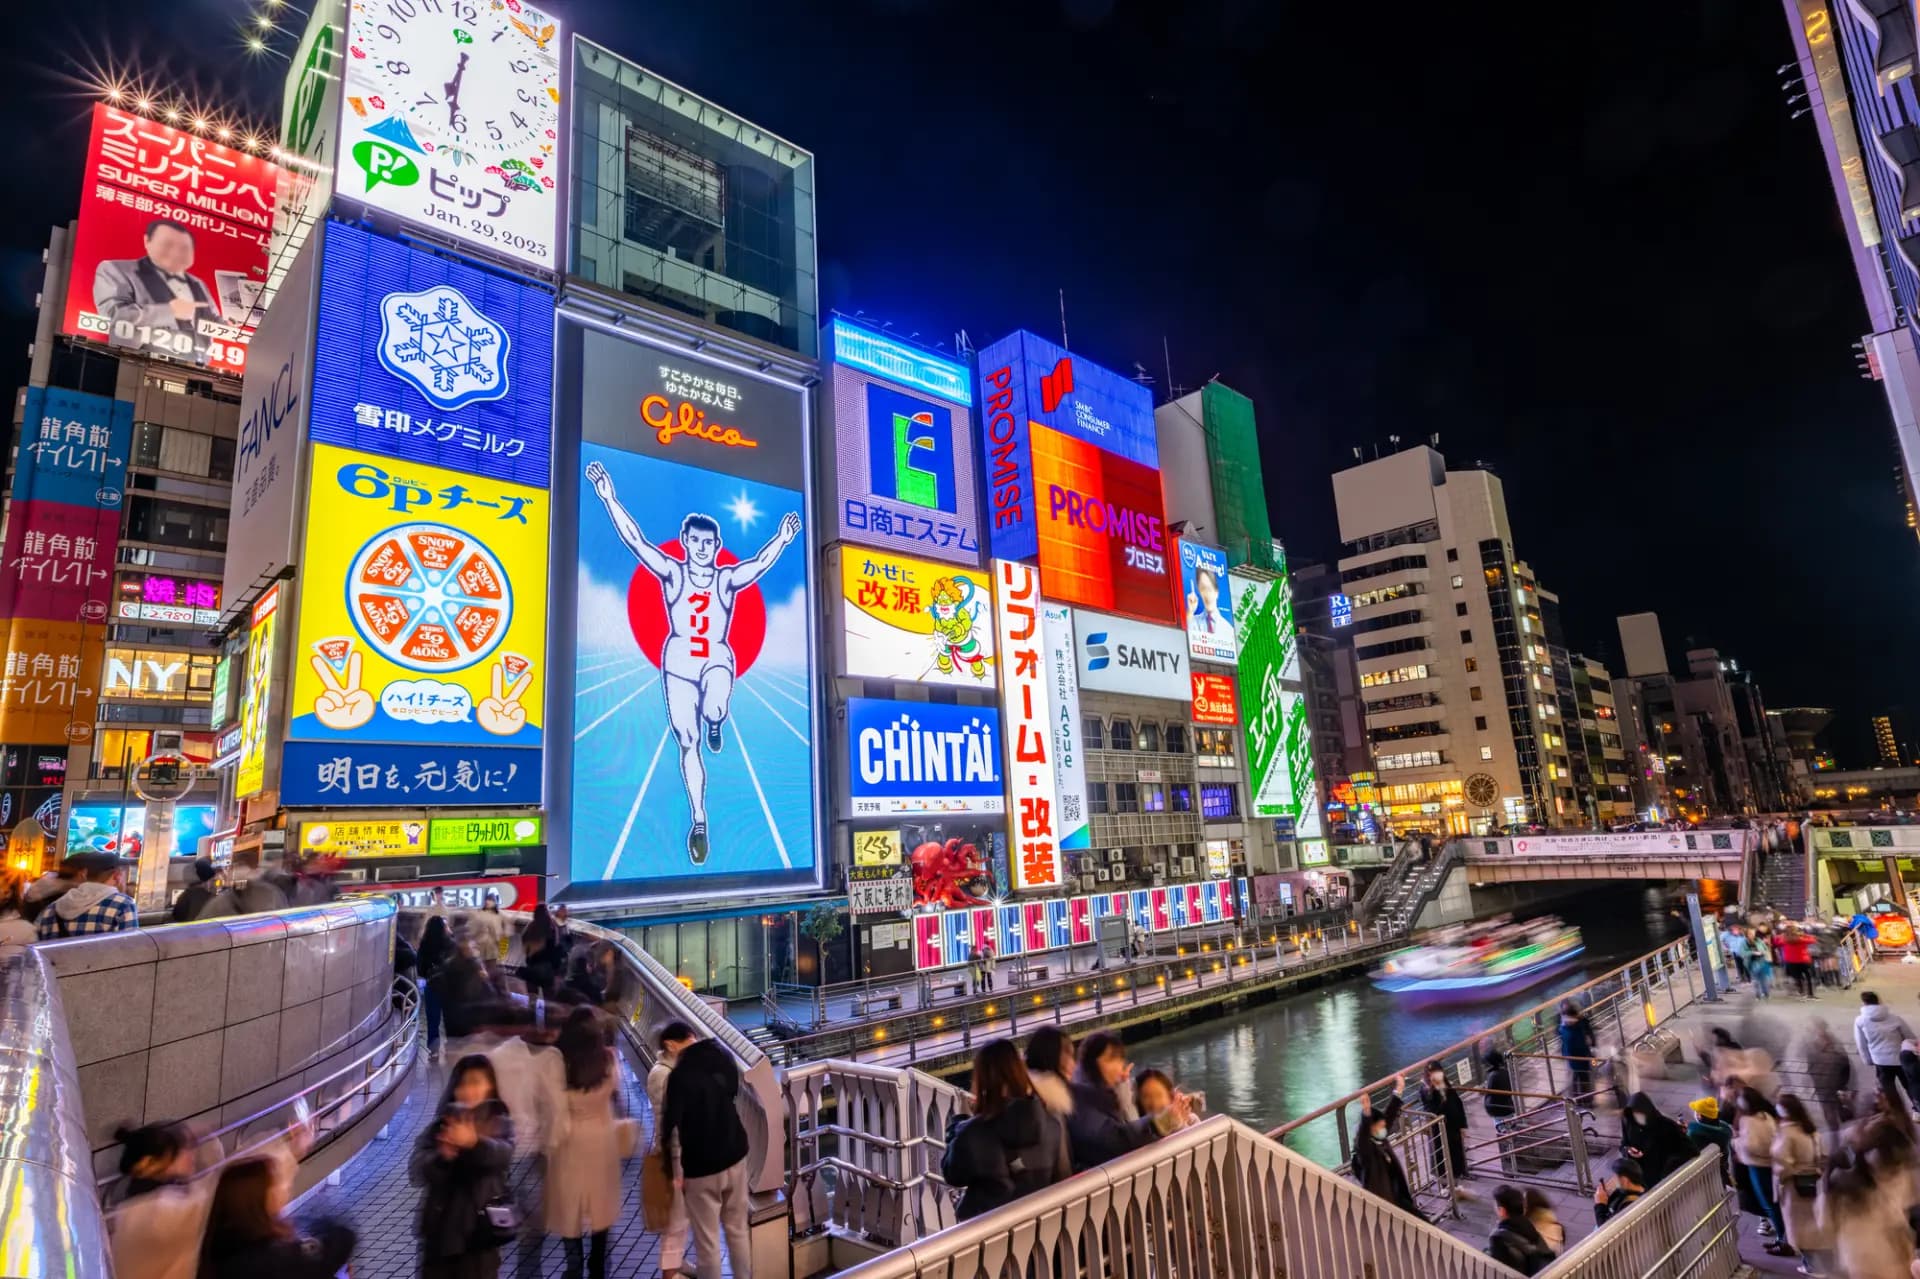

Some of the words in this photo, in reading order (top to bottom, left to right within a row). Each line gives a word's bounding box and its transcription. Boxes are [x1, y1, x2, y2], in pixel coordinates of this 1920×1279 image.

[451, 1, 477, 26] 12
[377, 24, 401, 44] 9
[386, 60, 410, 75] 8
[509, 59, 530, 74] 2
[416, 92, 439, 107] 7
[517, 88, 537, 107] 3
[452, 114, 467, 134] 6
[485, 120, 502, 141] 5
[510, 111, 528, 130] 4
[104, 112, 236, 167] スーパー
[98, 164, 180, 200] SUPER
[186, 191, 269, 228] MILLION
[430, 167, 511, 217] ピップ
[424, 203, 467, 229] Jan.
[502, 230, 548, 258] 2023
[658, 365, 743, 400] すこやかな毎日、
[665, 382, 736, 411] ゆたかな人生
[237, 352, 298, 483] FANCL
[641, 393, 758, 446] Glico
[1074, 400, 1094, 415] SMBC
[1075, 410, 1111, 431] CONSUMER
[40, 416, 112, 449] 龍角散
[353, 402, 525, 457] 雪印メグミルク
[1076, 418, 1106, 437] FINANCE
[27, 441, 107, 473] ダイレクト
[986, 366, 1022, 529] PROMISE
[845, 499, 978, 552] 日商エステム
[1050, 483, 1163, 551] PROMISE
[23, 530, 98, 561] 龍角散
[418, 535, 457, 550] SNOW
[423, 549, 448, 562] 6P
[9, 557, 92, 586] ダイレクト
[366, 544, 395, 577] SNOW
[862, 560, 915, 584] かぜに
[1125, 546, 1165, 574] プロミス
[474, 560, 498, 593] SNOW
[857, 579, 923, 615] 改源
[364, 601, 390, 636] SNOW
[471, 615, 496, 646] SNOW
[687, 591, 711, 658] グリコ
[4, 651, 81, 679] 龍角散
[410, 645, 449, 659] SNOW
[1116, 643, 1180, 674] SAMTY
[109, 657, 183, 691] NY
[1003, 562, 1056, 885] リフォーム・改装
[1060, 704, 1073, 768] Asue
